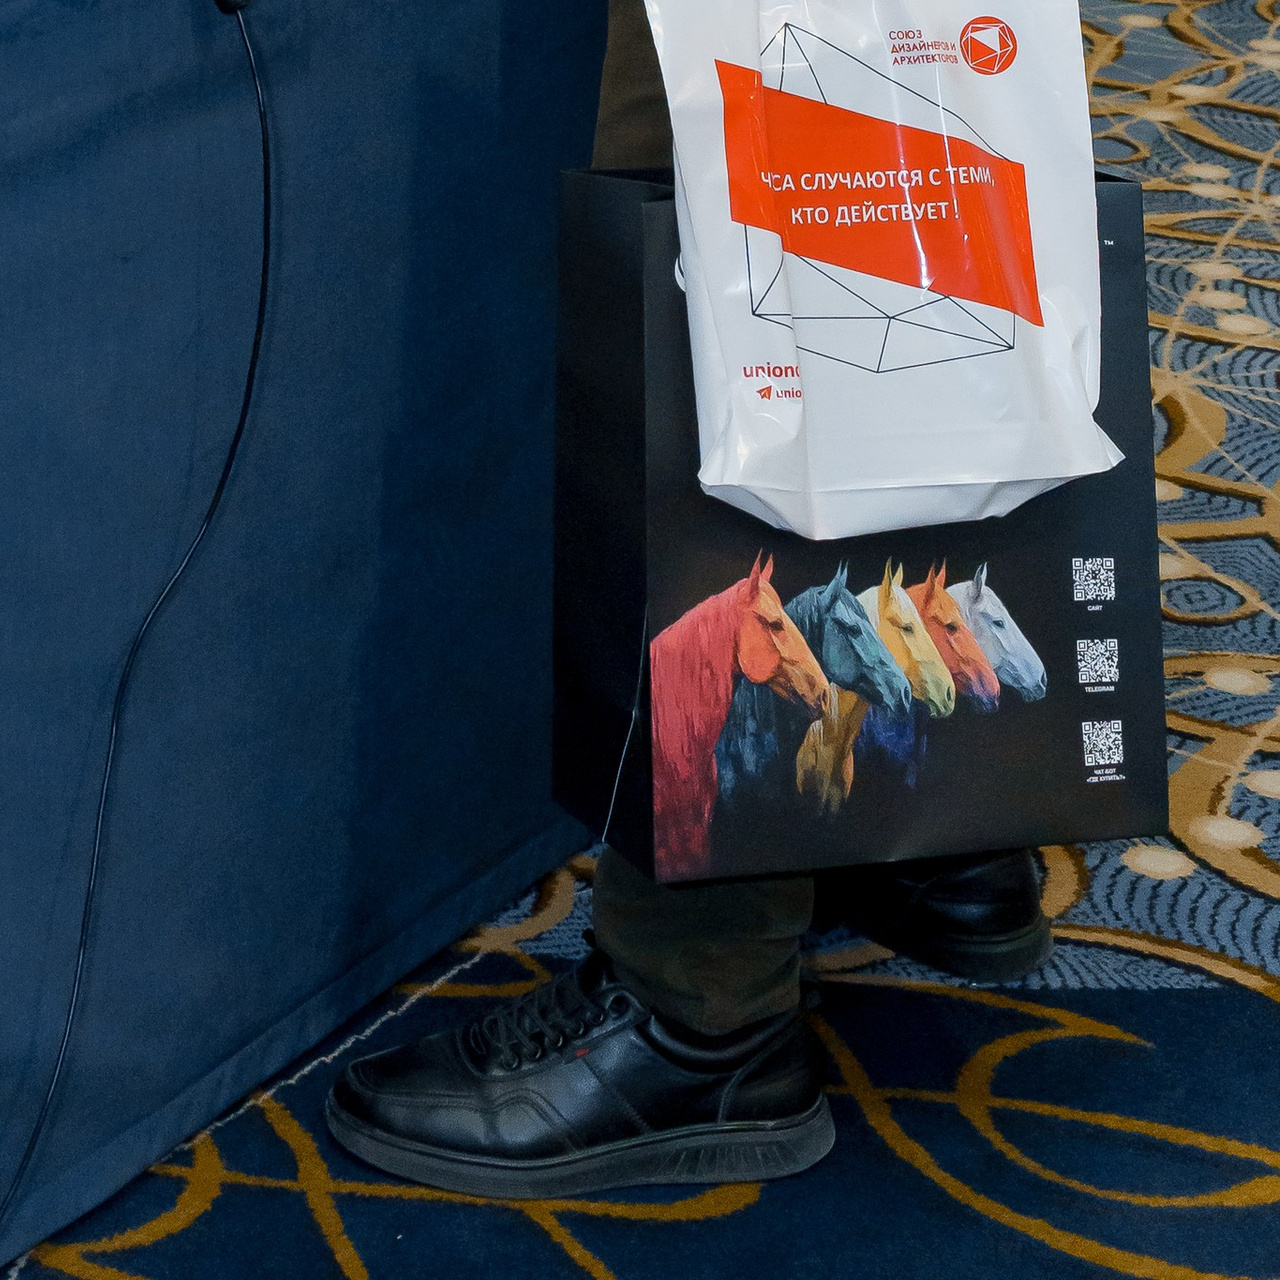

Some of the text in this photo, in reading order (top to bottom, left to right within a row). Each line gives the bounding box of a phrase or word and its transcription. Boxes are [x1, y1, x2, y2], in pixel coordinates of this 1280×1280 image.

[889, 29, 922, 40] СОЮЗ
[891, 40, 950, 54] ДИЗАЙНЕРОВ
[892, 53, 959, 66] АРХИТЕКТОРОВ
[800, 169, 923, 191] СЛУЧАЮТСЯ
[928, 168, 942, 185] С
[945, 166, 996, 188] ТЕМИ,
[791, 206, 830, 225] КТО
[835, 200, 949, 227] ДЕЙСТВУЕТ
[776, 387, 802, 399] unio
